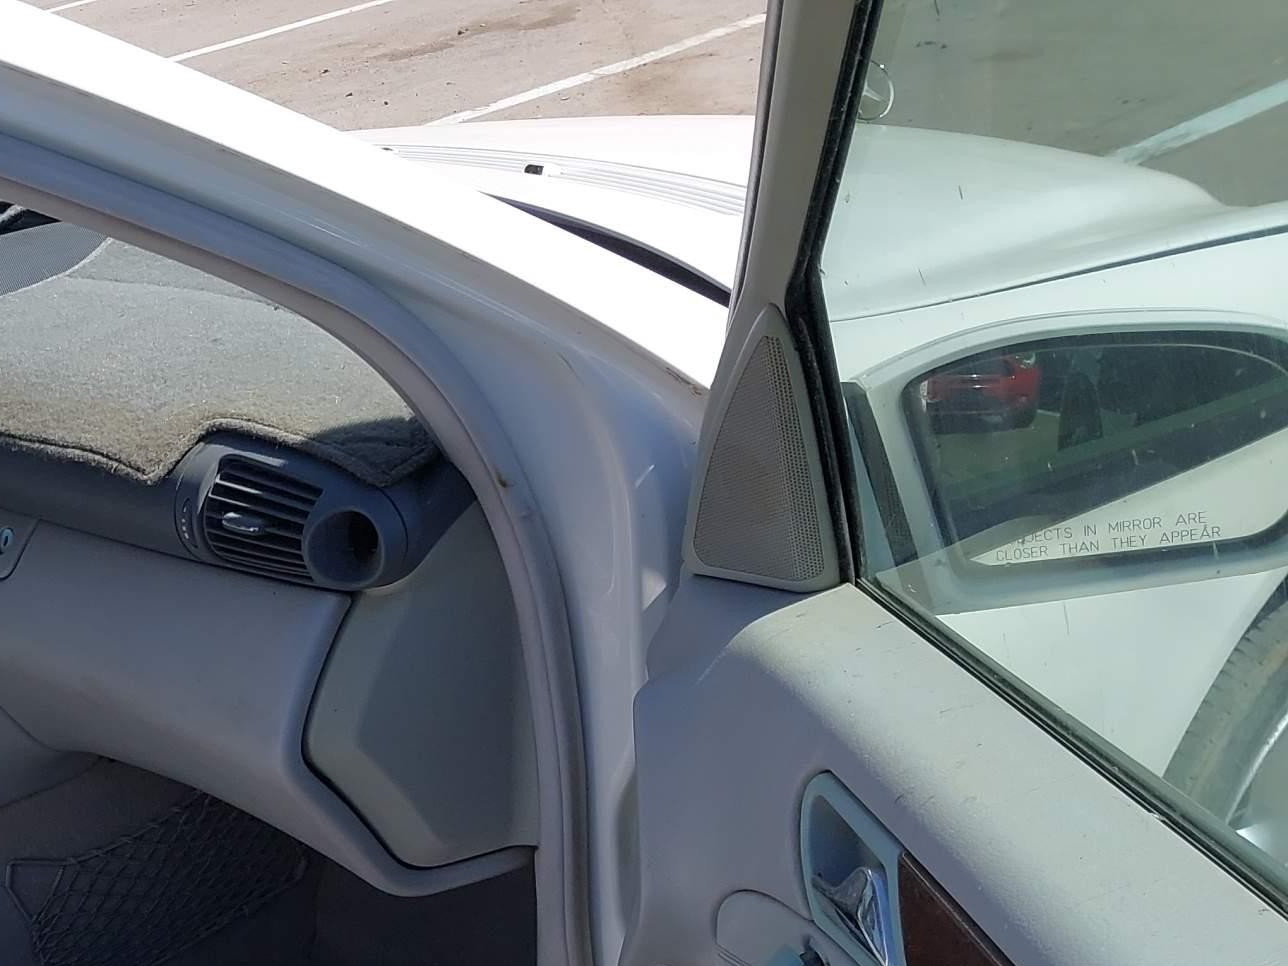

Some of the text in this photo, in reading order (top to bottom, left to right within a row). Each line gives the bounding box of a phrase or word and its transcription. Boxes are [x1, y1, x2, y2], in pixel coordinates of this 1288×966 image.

[996, 526, 1222, 562] CLOSER THAN THEY APPEAR
[1015, 511, 1209, 546] JECTS IN MIRROR ARE
